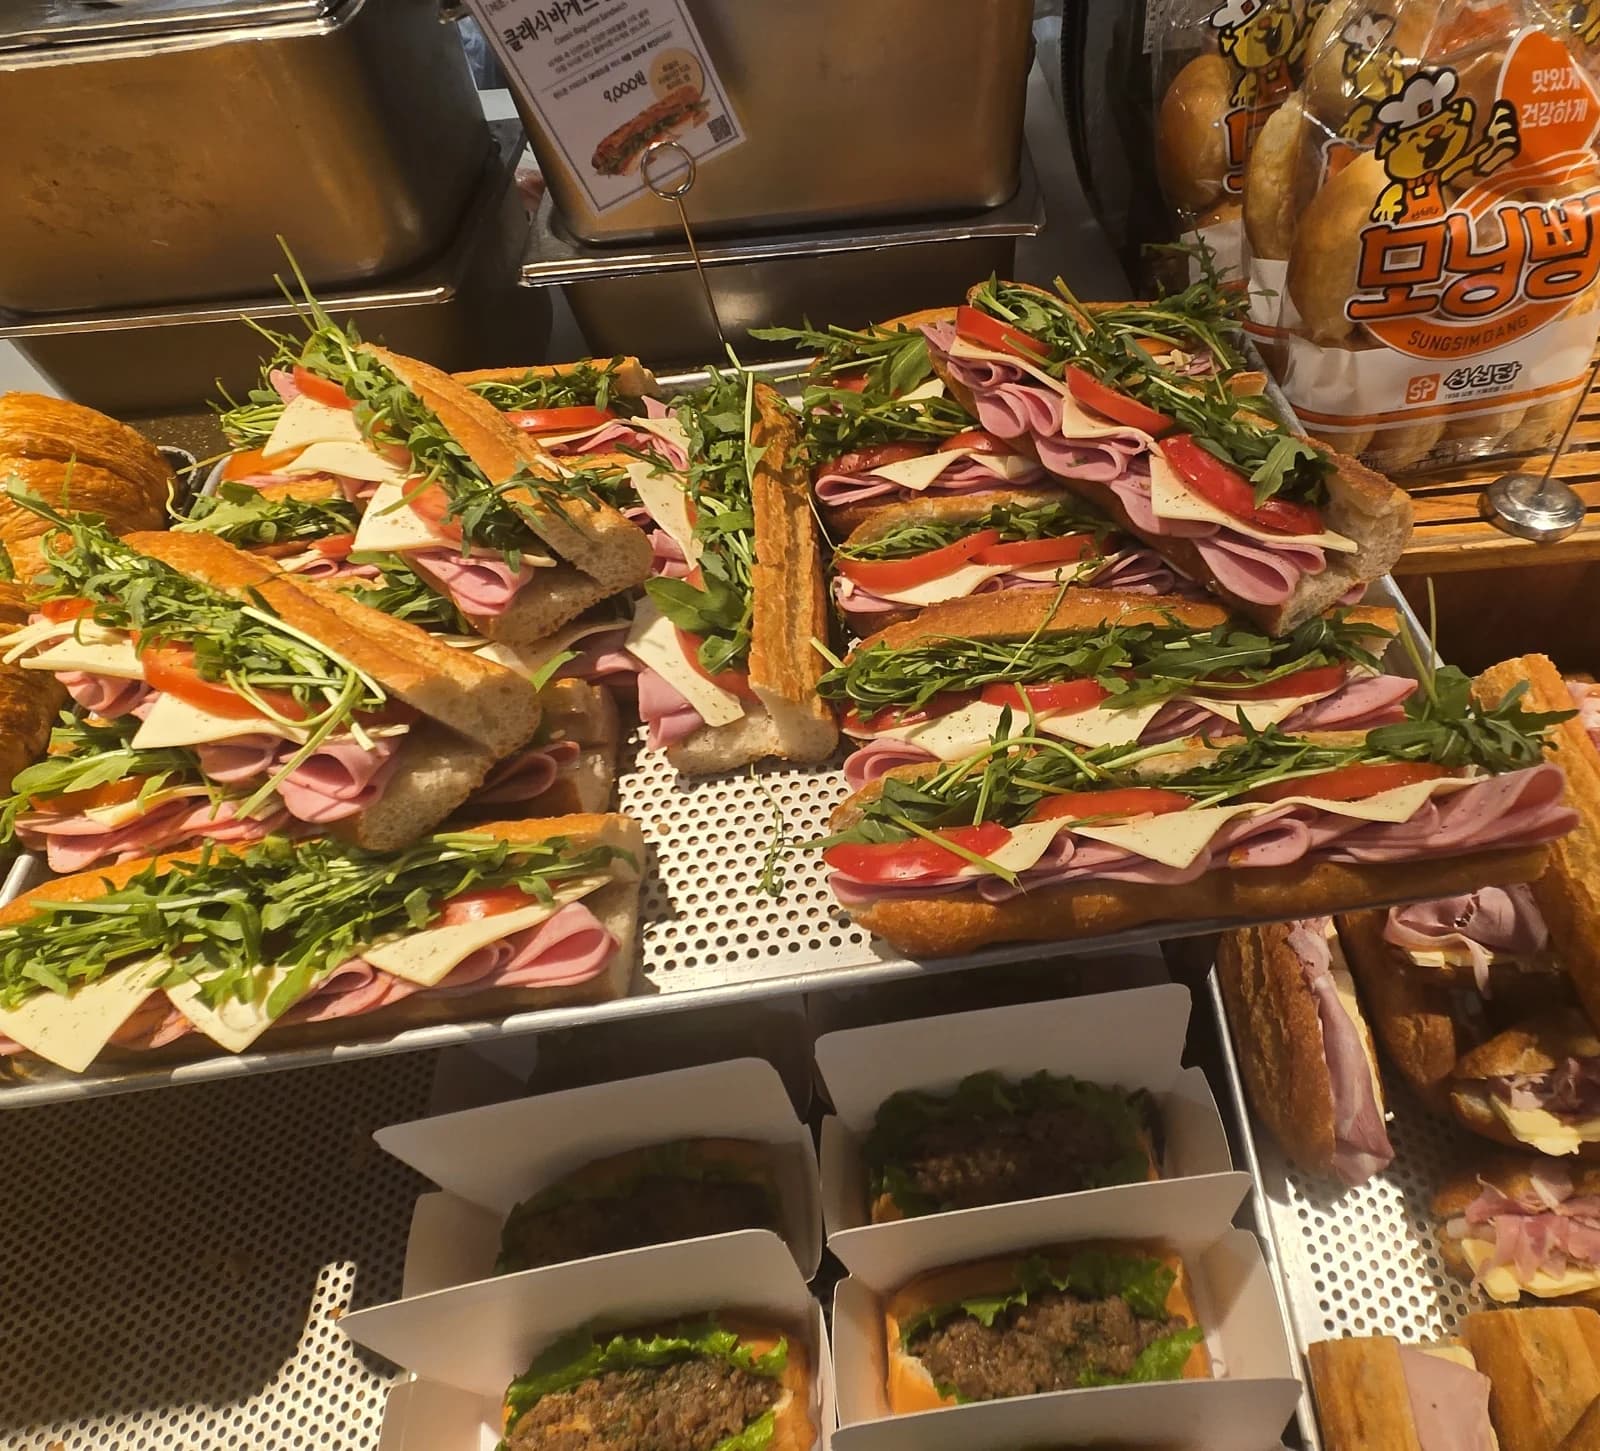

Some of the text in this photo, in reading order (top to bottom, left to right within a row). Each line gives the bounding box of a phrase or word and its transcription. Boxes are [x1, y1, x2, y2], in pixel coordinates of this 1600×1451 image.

[603, 70, 648, 103] 9,000원
[1532, 67, 1580, 94] 맛있게
[1521, 98, 1588, 128] 건강하게
[1346, 192, 1600, 321] 모닝빵
[1408, 315, 1528, 351] SUNGSIMDANG
[1443, 361, 1522, 391] 성심당
